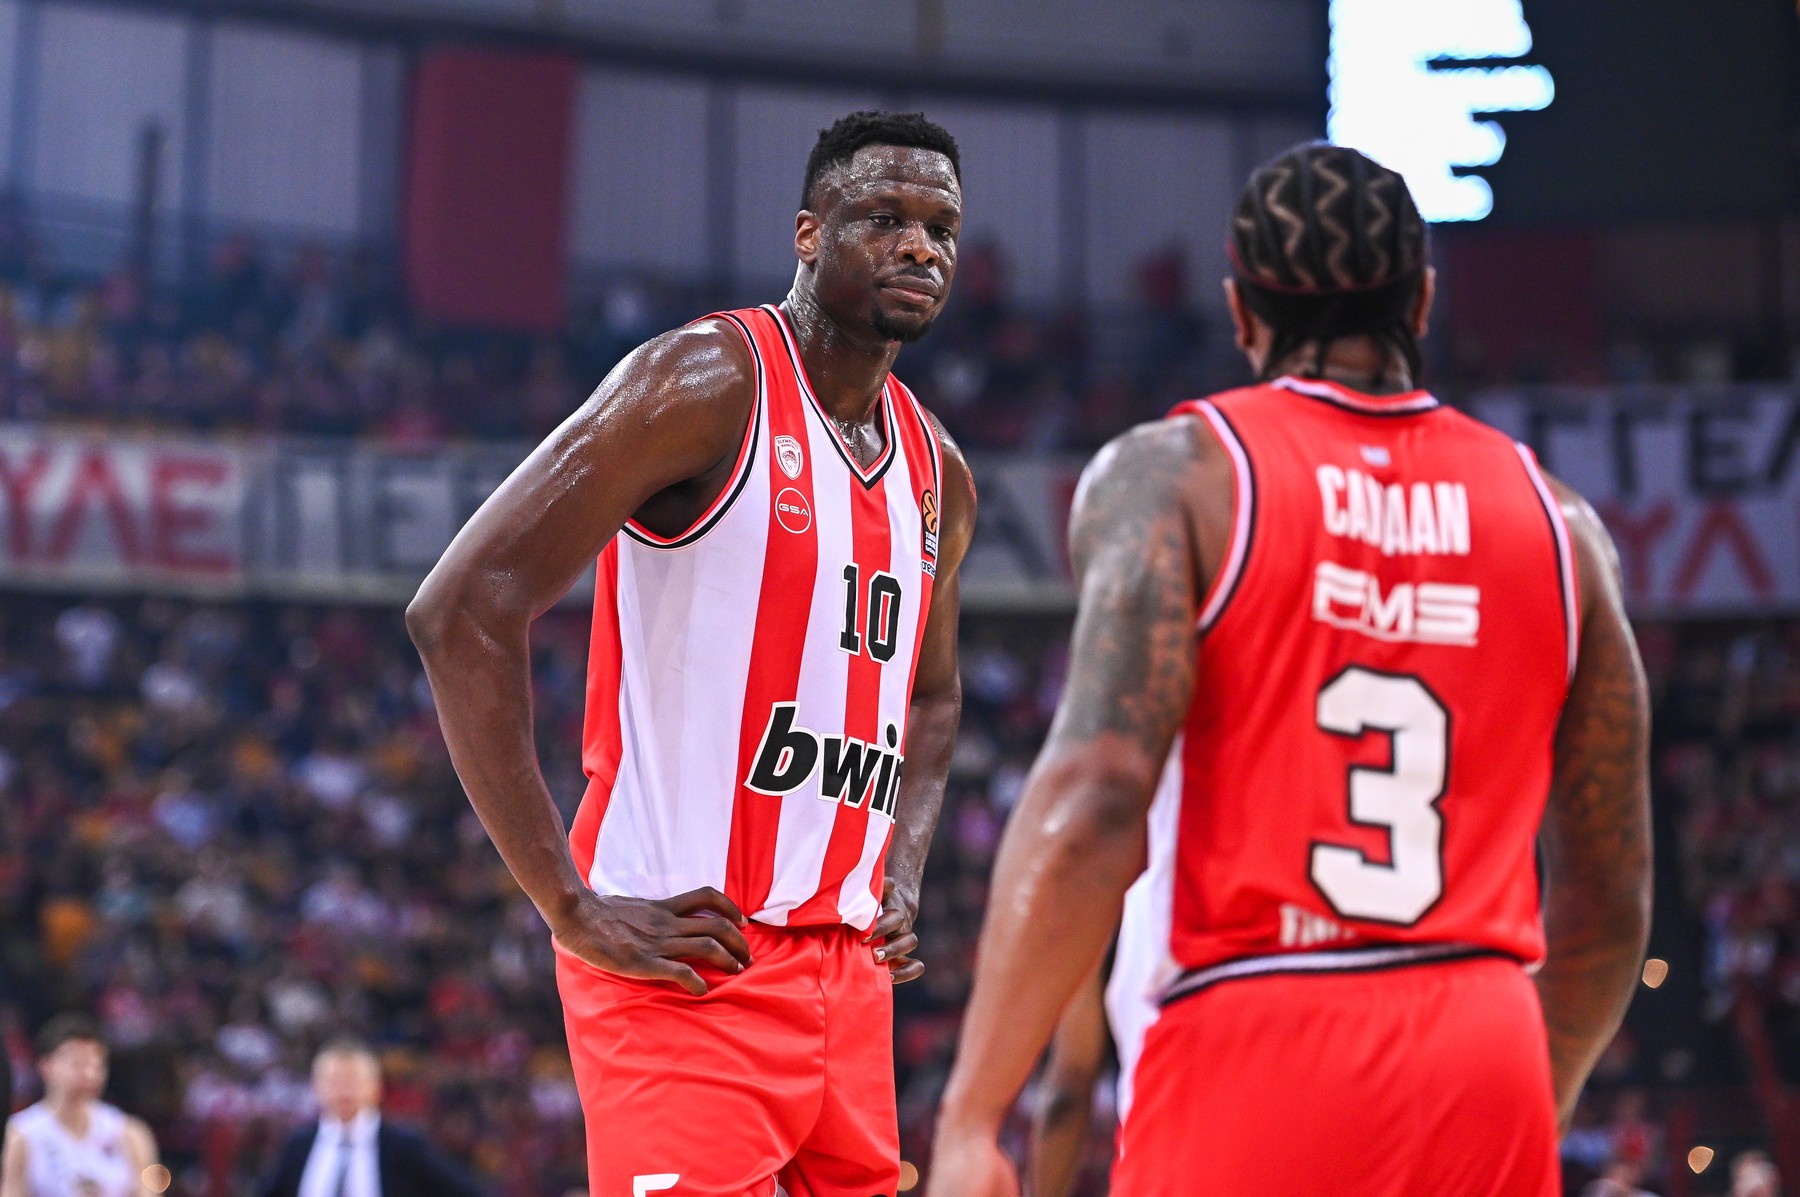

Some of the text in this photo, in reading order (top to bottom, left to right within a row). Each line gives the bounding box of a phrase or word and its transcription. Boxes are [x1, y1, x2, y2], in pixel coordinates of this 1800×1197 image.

[778, 503, 809, 517] GSA
[838, 562, 902, 664] 10
[1307, 664, 1453, 926] 3
